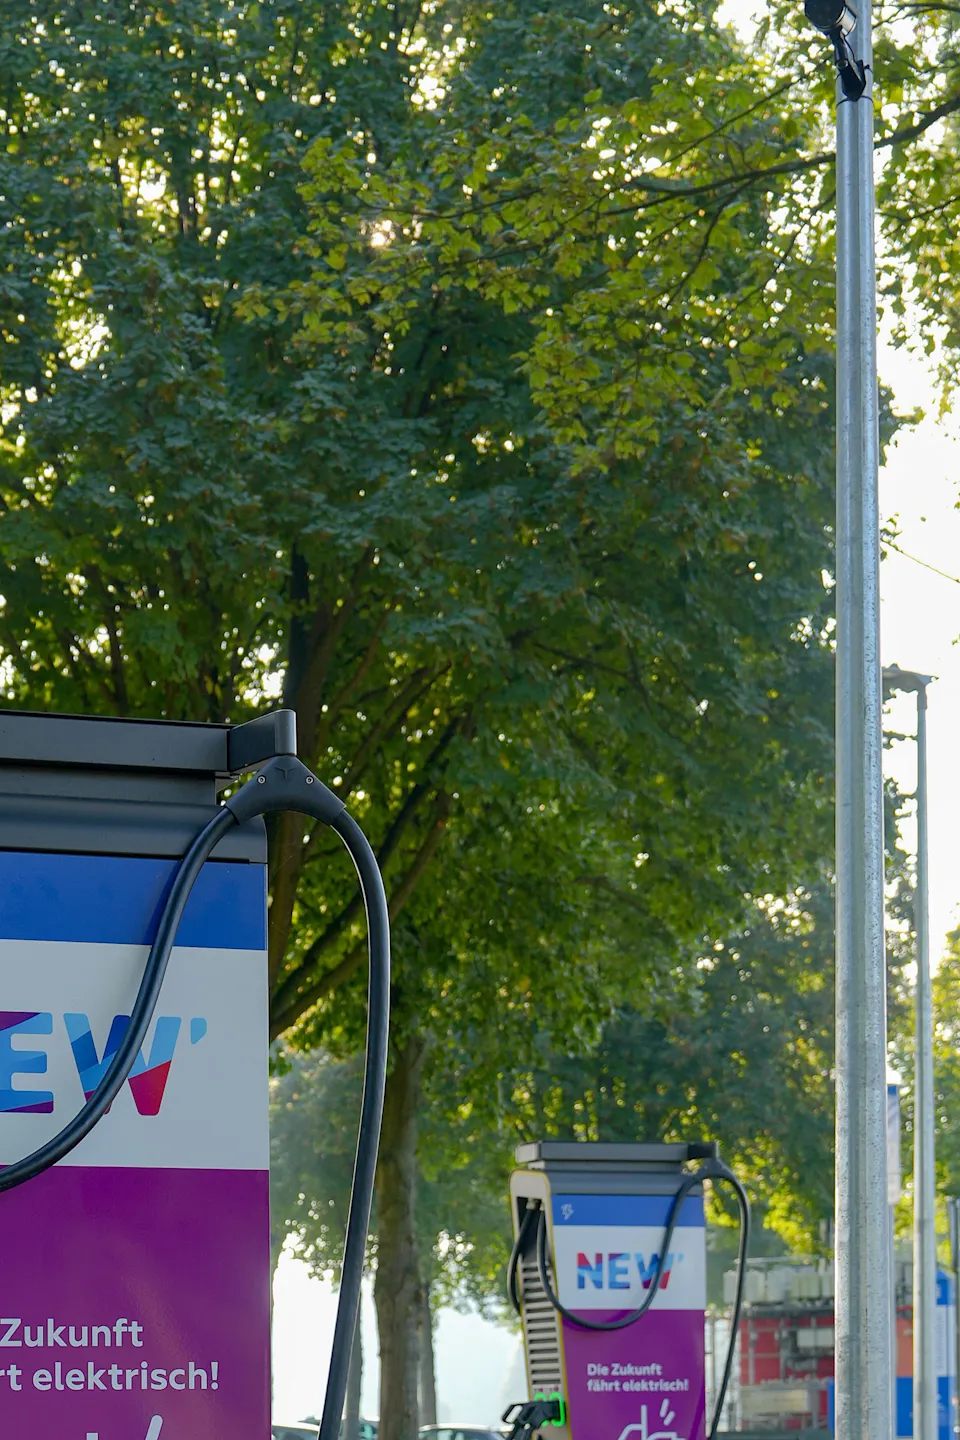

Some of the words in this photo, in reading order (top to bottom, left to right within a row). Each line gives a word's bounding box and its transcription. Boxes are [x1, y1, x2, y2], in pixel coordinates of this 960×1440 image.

[0, 1318, 144, 1348] Zukunft
[32, 1361, 220, 1391] elektrisch!
[586, 1363, 610, 1376] Die
[610, 1362, 663, 1376] Zukunft
[587, 1378, 620, 1392] fährt
[622, 1378, 689, 1392] elektrisch!
